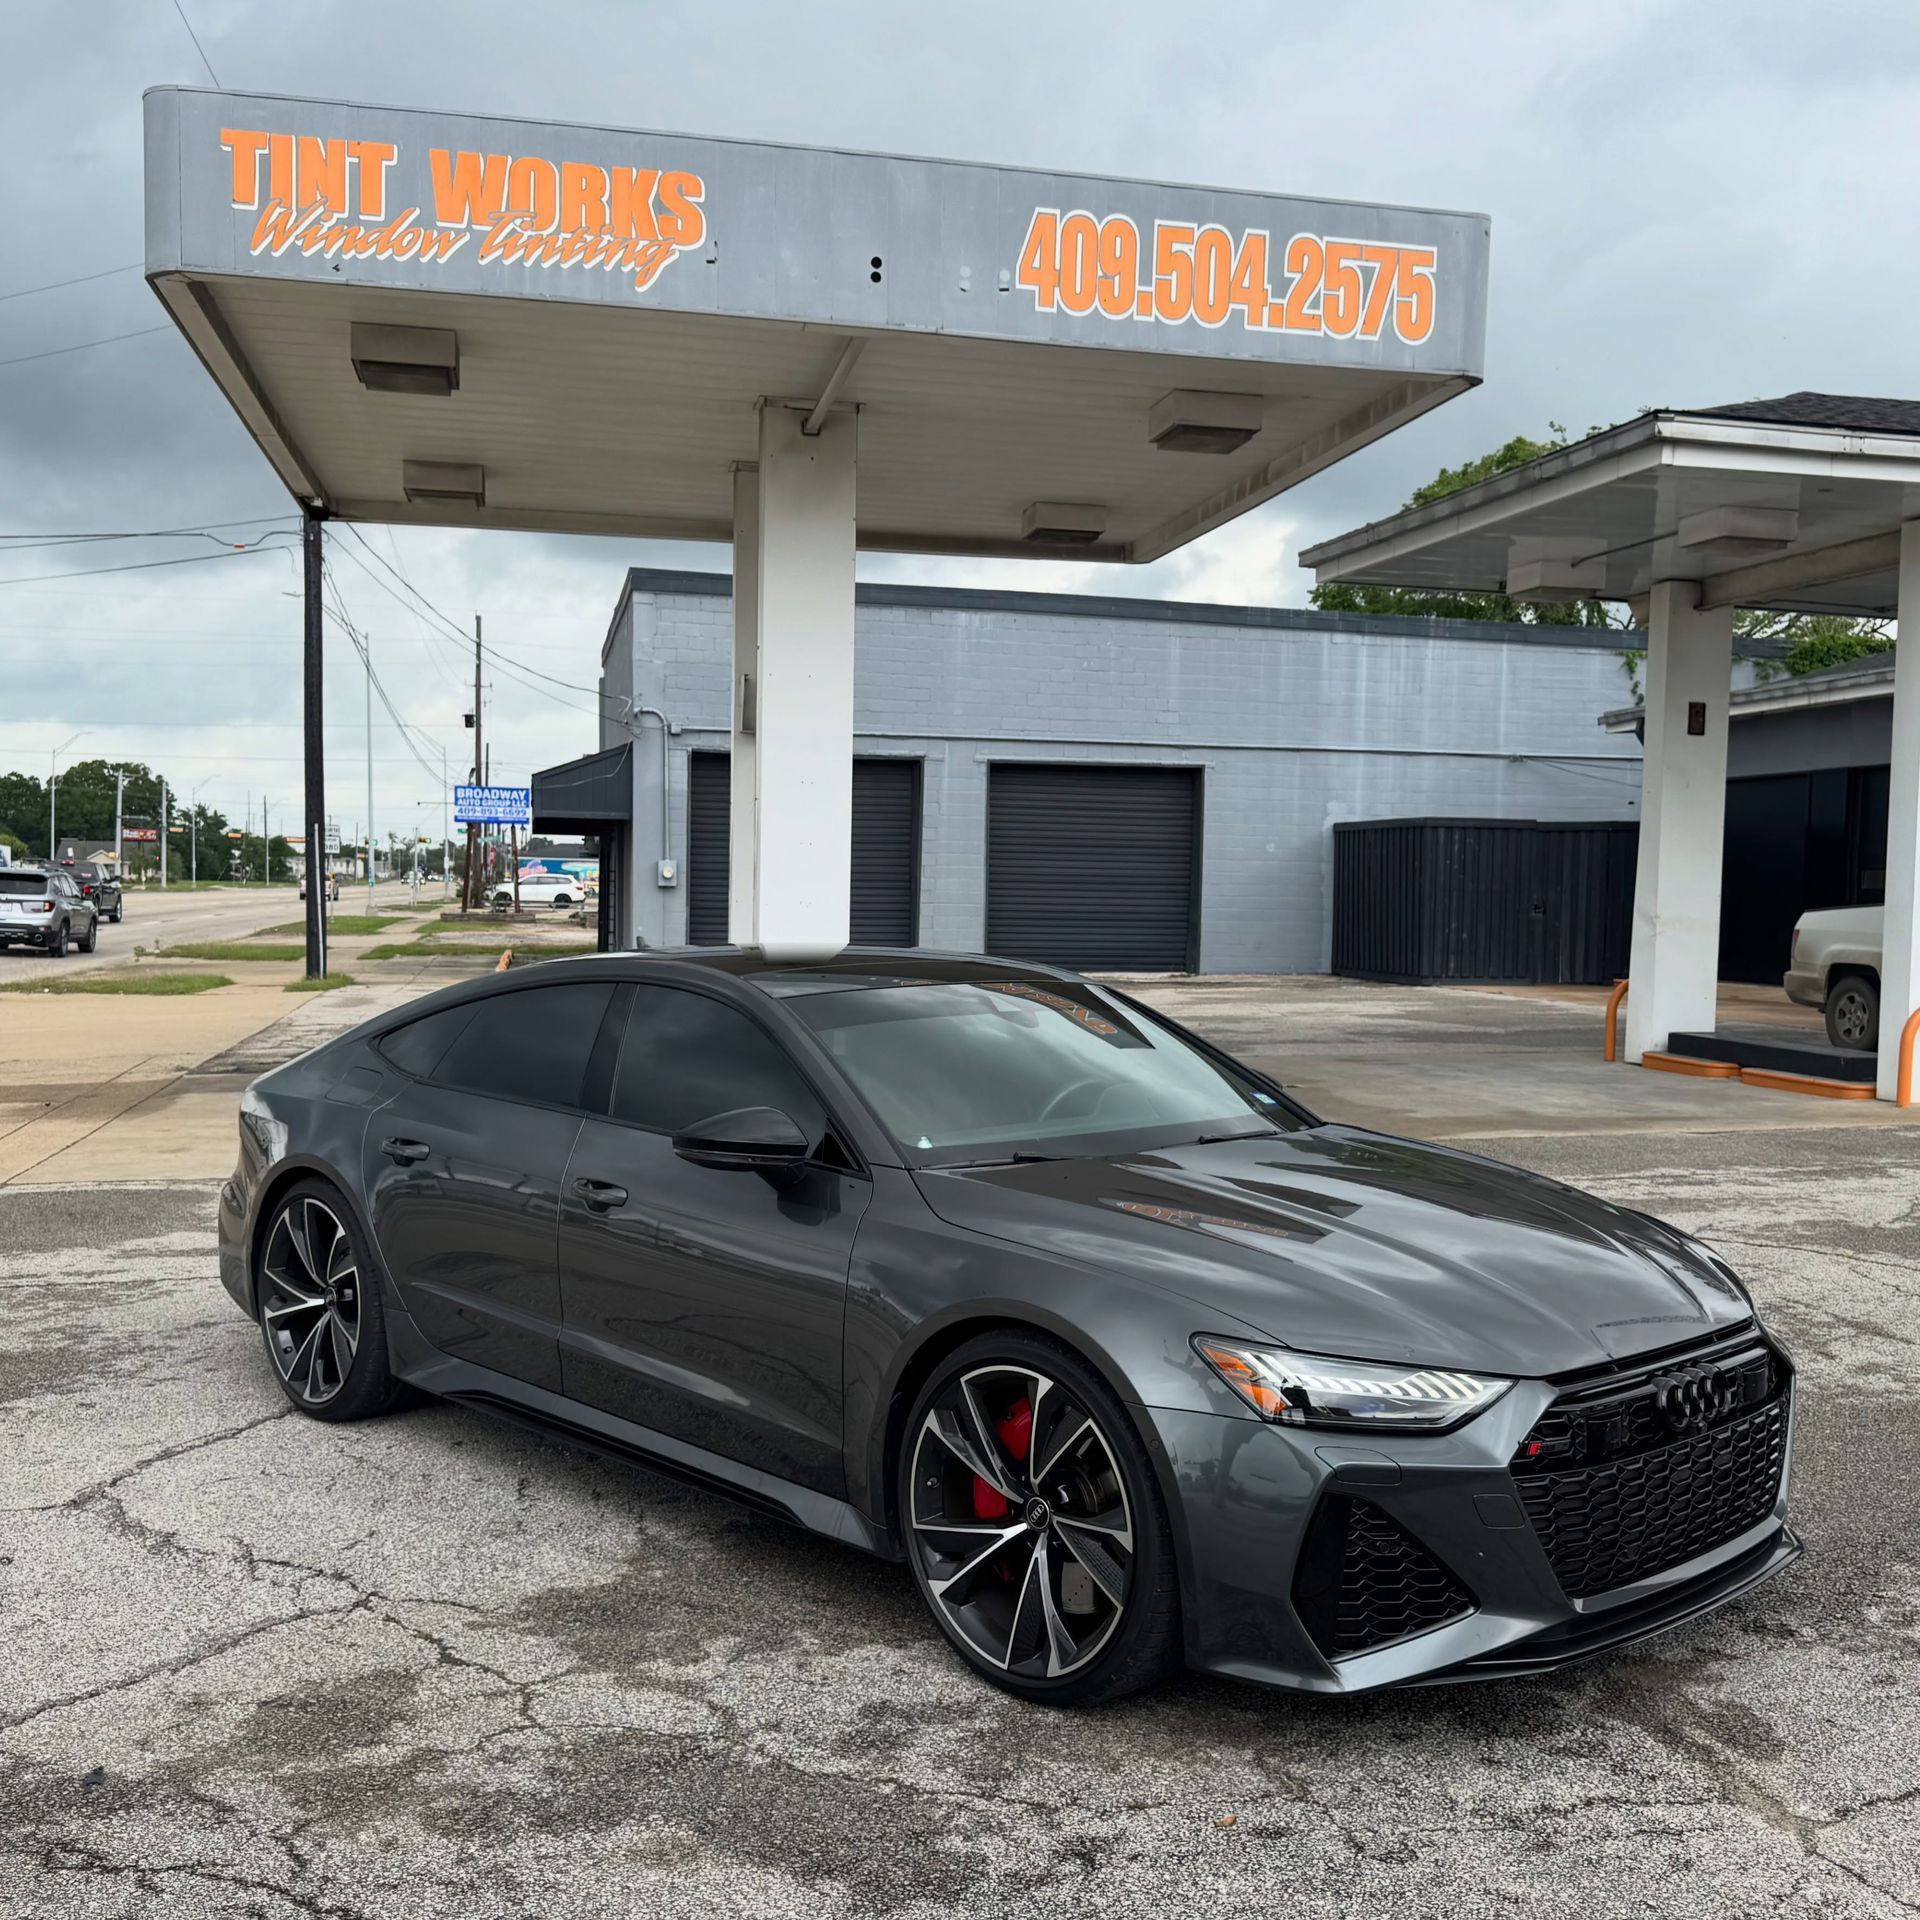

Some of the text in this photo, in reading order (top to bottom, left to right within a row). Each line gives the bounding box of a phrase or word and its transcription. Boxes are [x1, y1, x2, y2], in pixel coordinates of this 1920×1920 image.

[220, 128, 706, 251] TINT WORKS
[250, 197, 679, 292] Window Tinting
[1016, 206, 1437, 346] 409.504.2575
[457, 788, 526, 800] BROADWAY
[481, 799, 511, 807] GROUP
